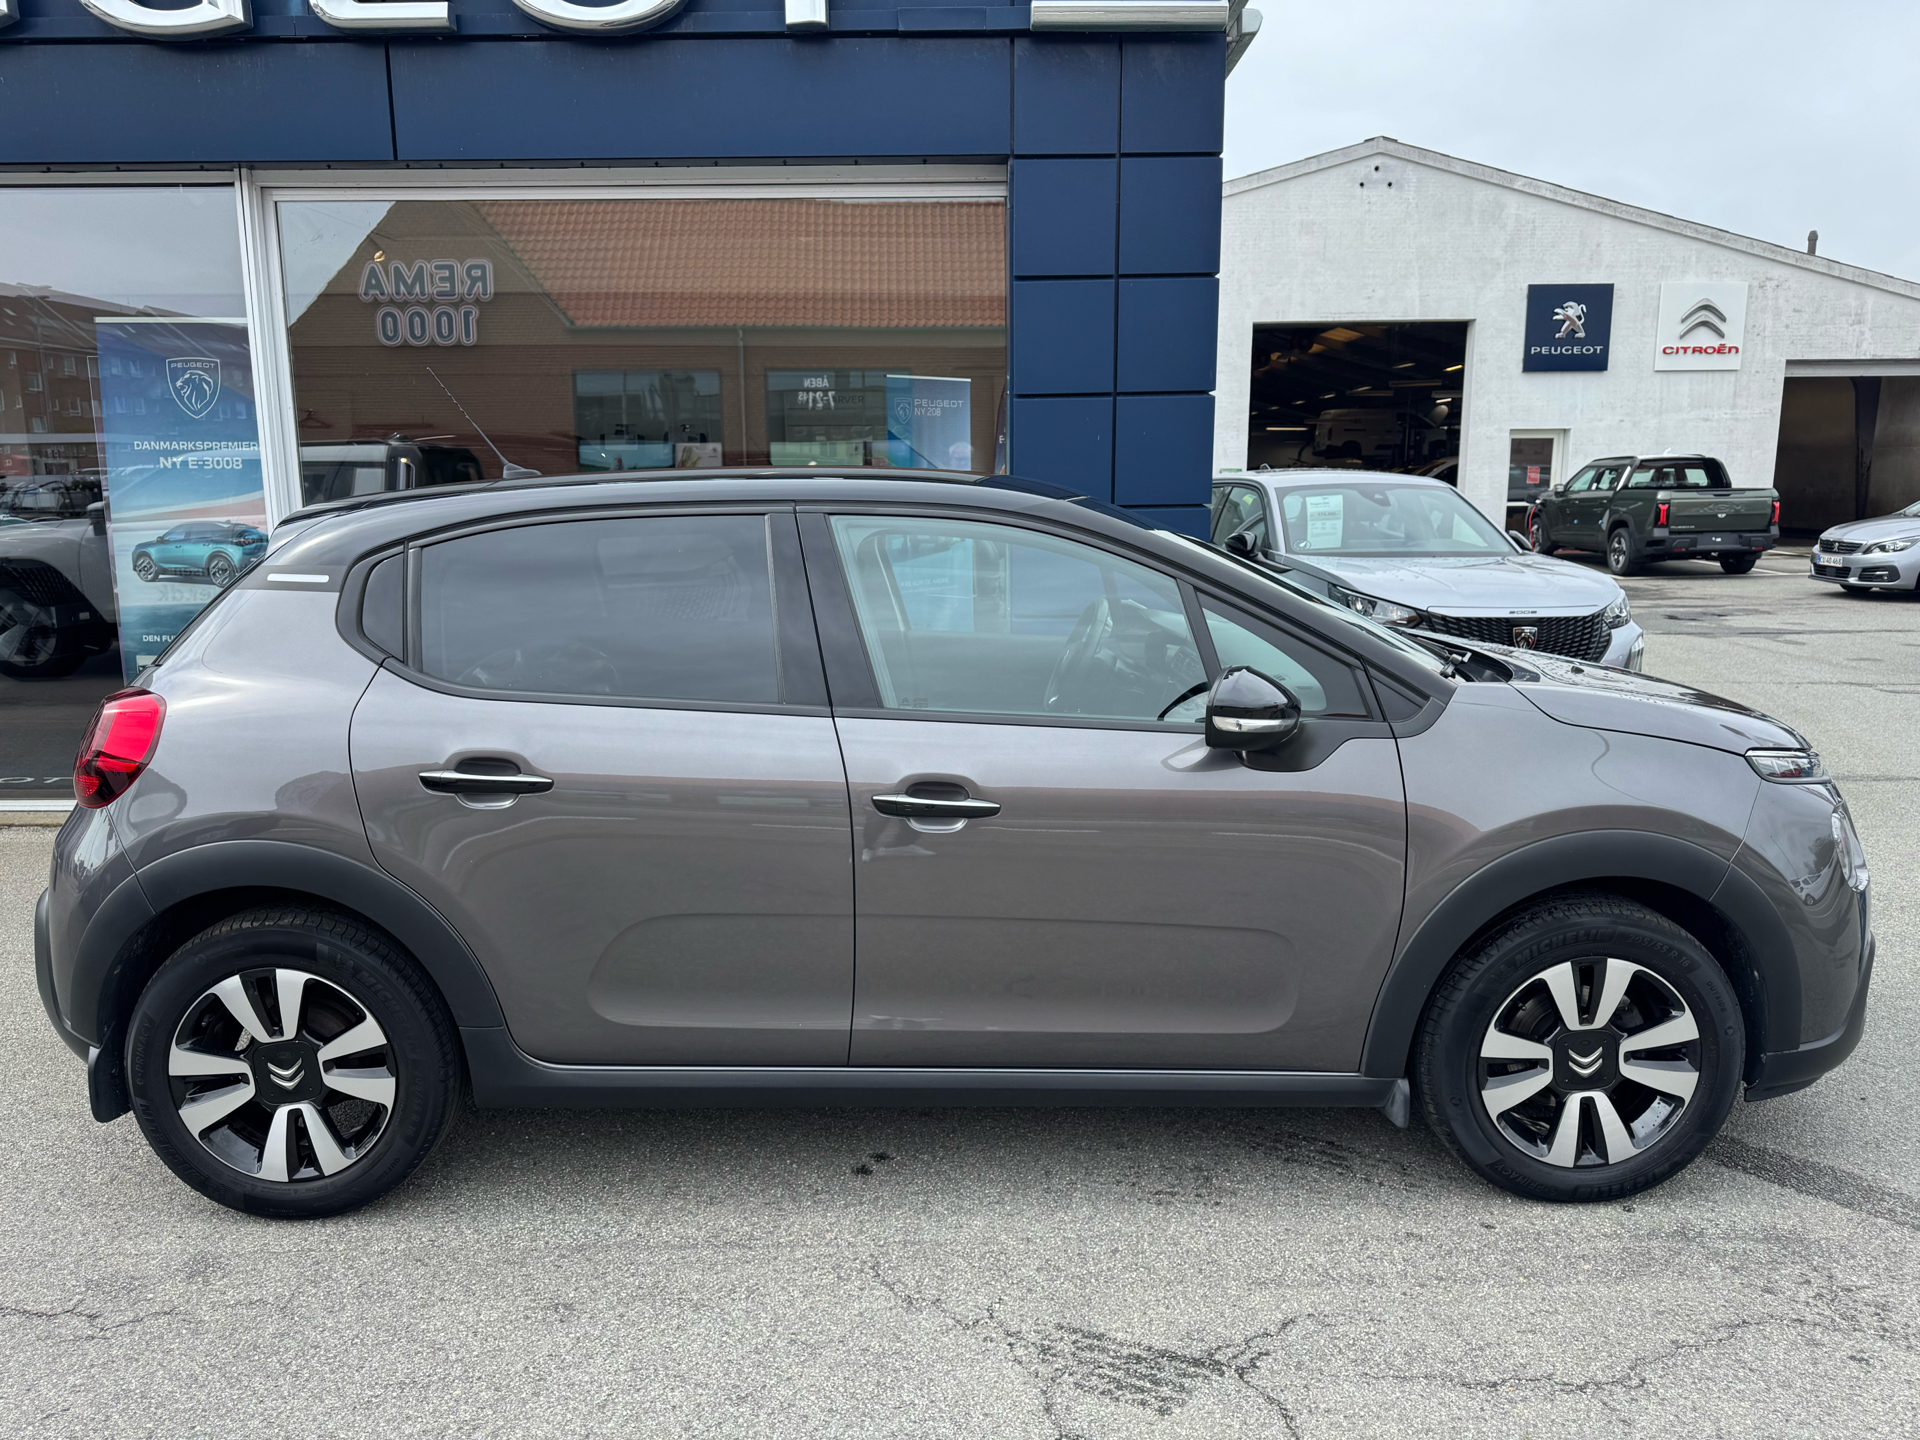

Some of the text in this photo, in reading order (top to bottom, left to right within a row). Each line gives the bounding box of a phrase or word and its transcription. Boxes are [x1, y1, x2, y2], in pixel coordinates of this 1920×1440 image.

[1530, 345, 1604, 355] PEUGEOT
[914, 399, 964, 408] PEUGEOT
[914, 407, 942, 416] NY 208
[133, 441, 260, 451] DANMARKSPREMIER
[159, 456, 243, 470] NY E-3008
[142, 634, 176, 642] DEN FU
[1515, 928, 1613, 967] MICHELIN
[1706, 980, 1727, 1013] OUTSIDE
[357, 970, 421, 1058] MICHELIN
